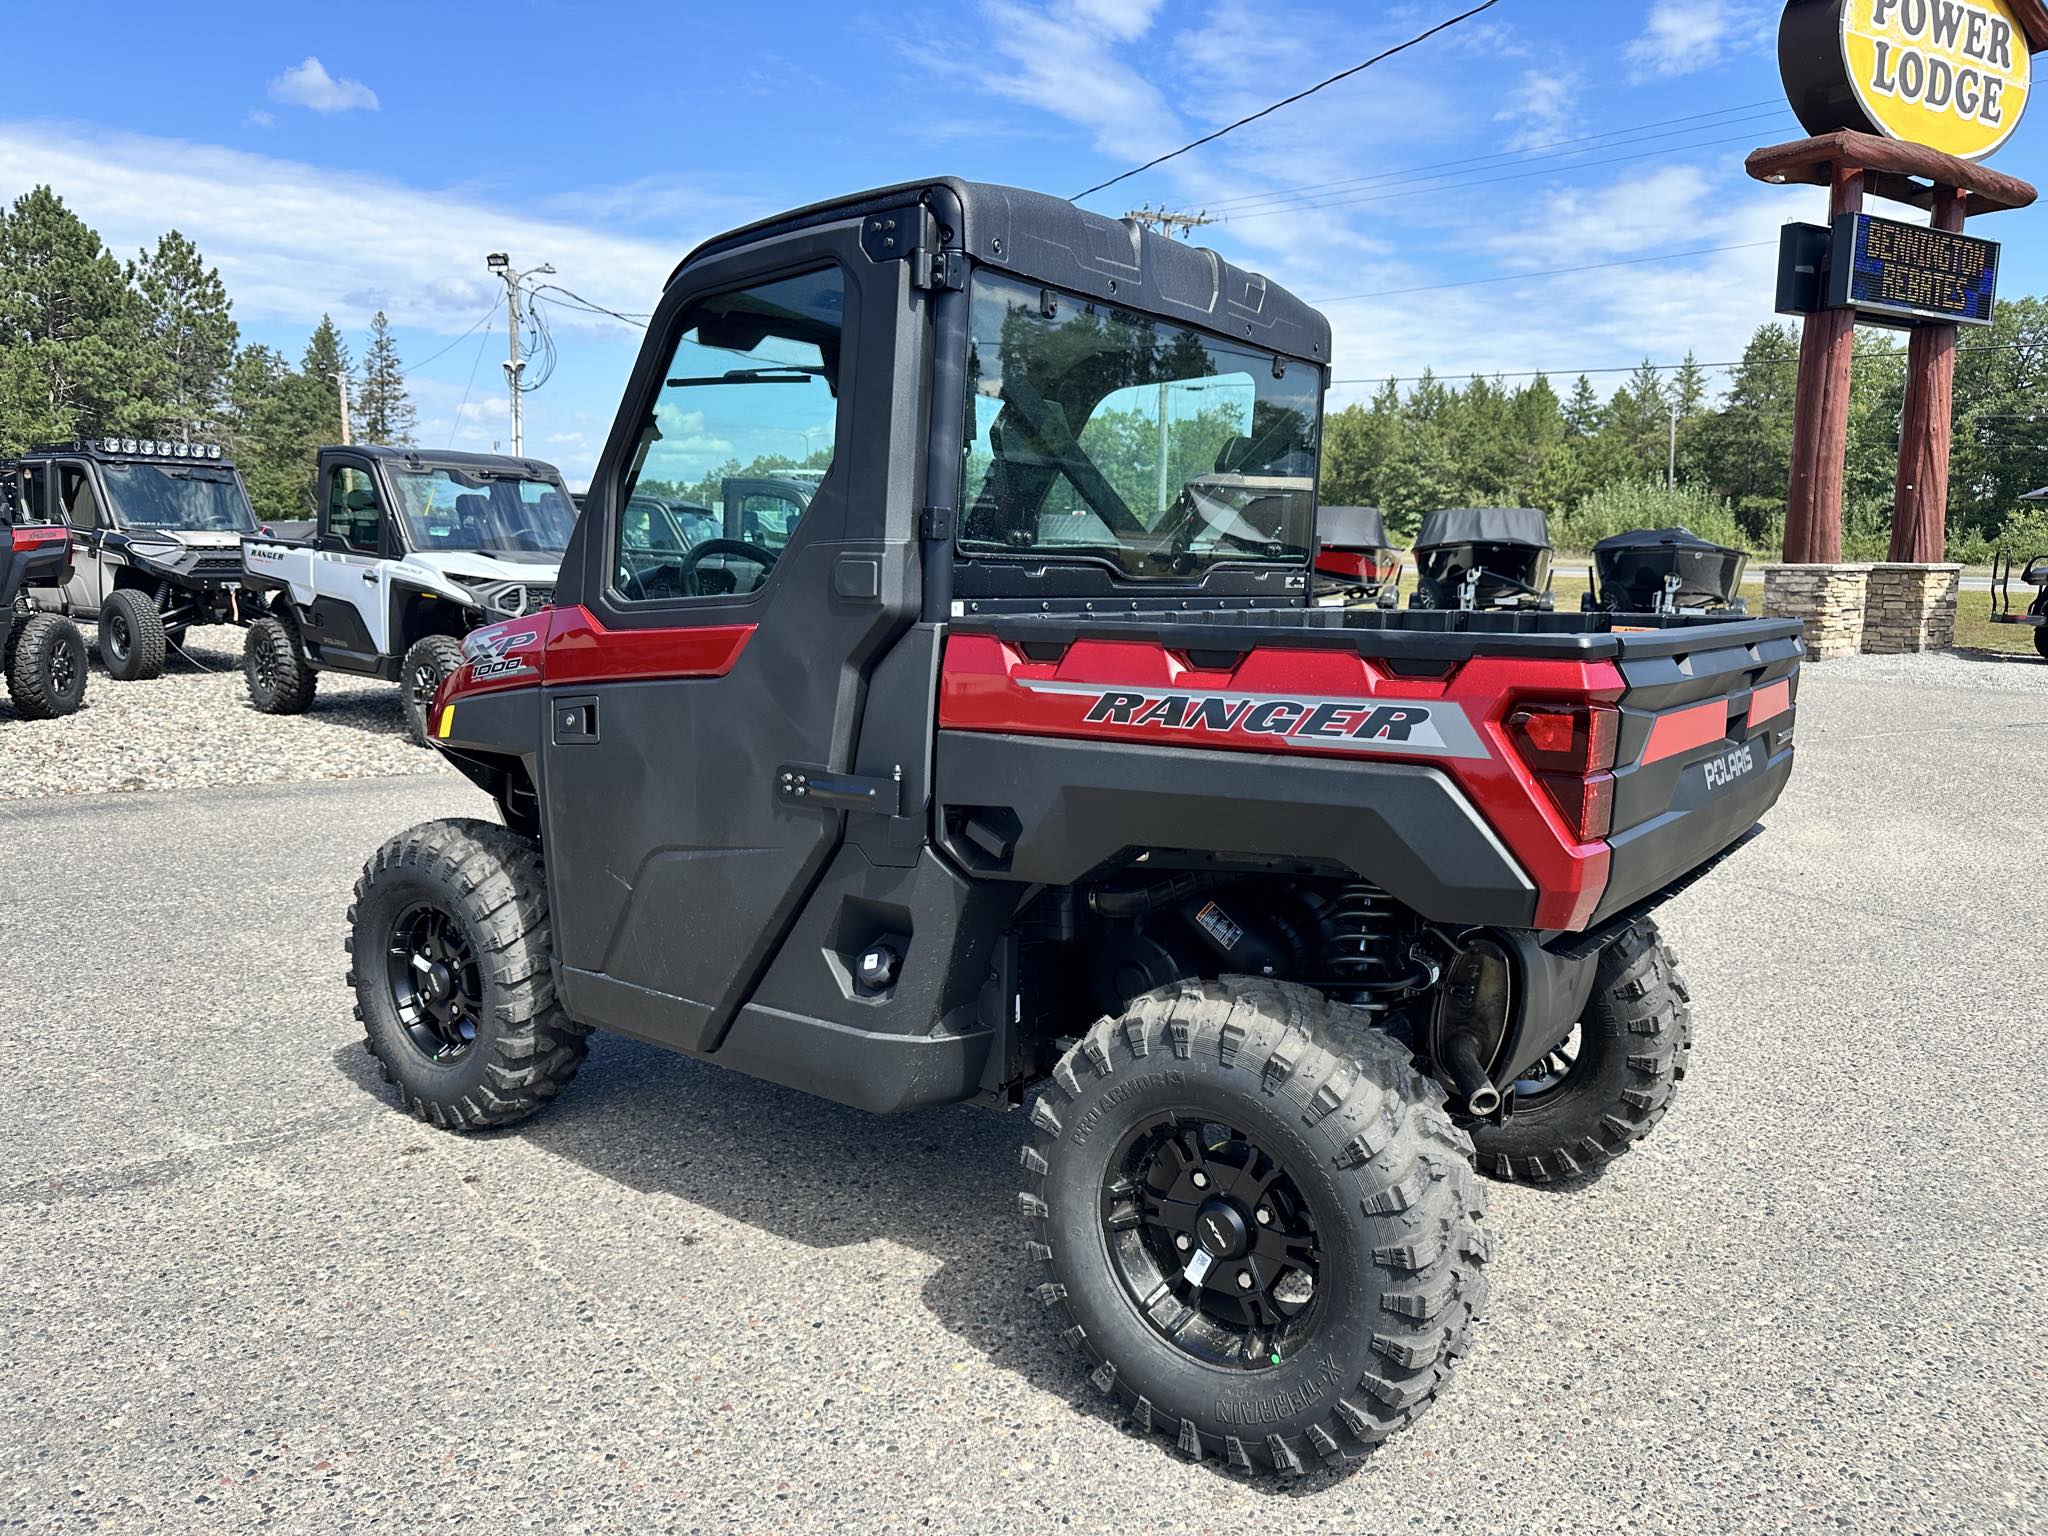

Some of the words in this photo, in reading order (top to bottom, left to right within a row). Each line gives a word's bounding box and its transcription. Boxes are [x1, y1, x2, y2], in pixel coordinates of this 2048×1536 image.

[1873, 0, 2010, 69] POWER
[1873, 41, 2002, 123] LODGE
[1881, 263, 1968, 310] REBATES
[251, 549, 285, 561] RANGER
[465, 631, 538, 664] XP
[472, 657, 522, 678] 1000
[1083, 691, 1432, 742] RANGER
[1703, 745, 1753, 790] POLARIS
[1215, 1353, 1345, 1424] X-TERRAIN
